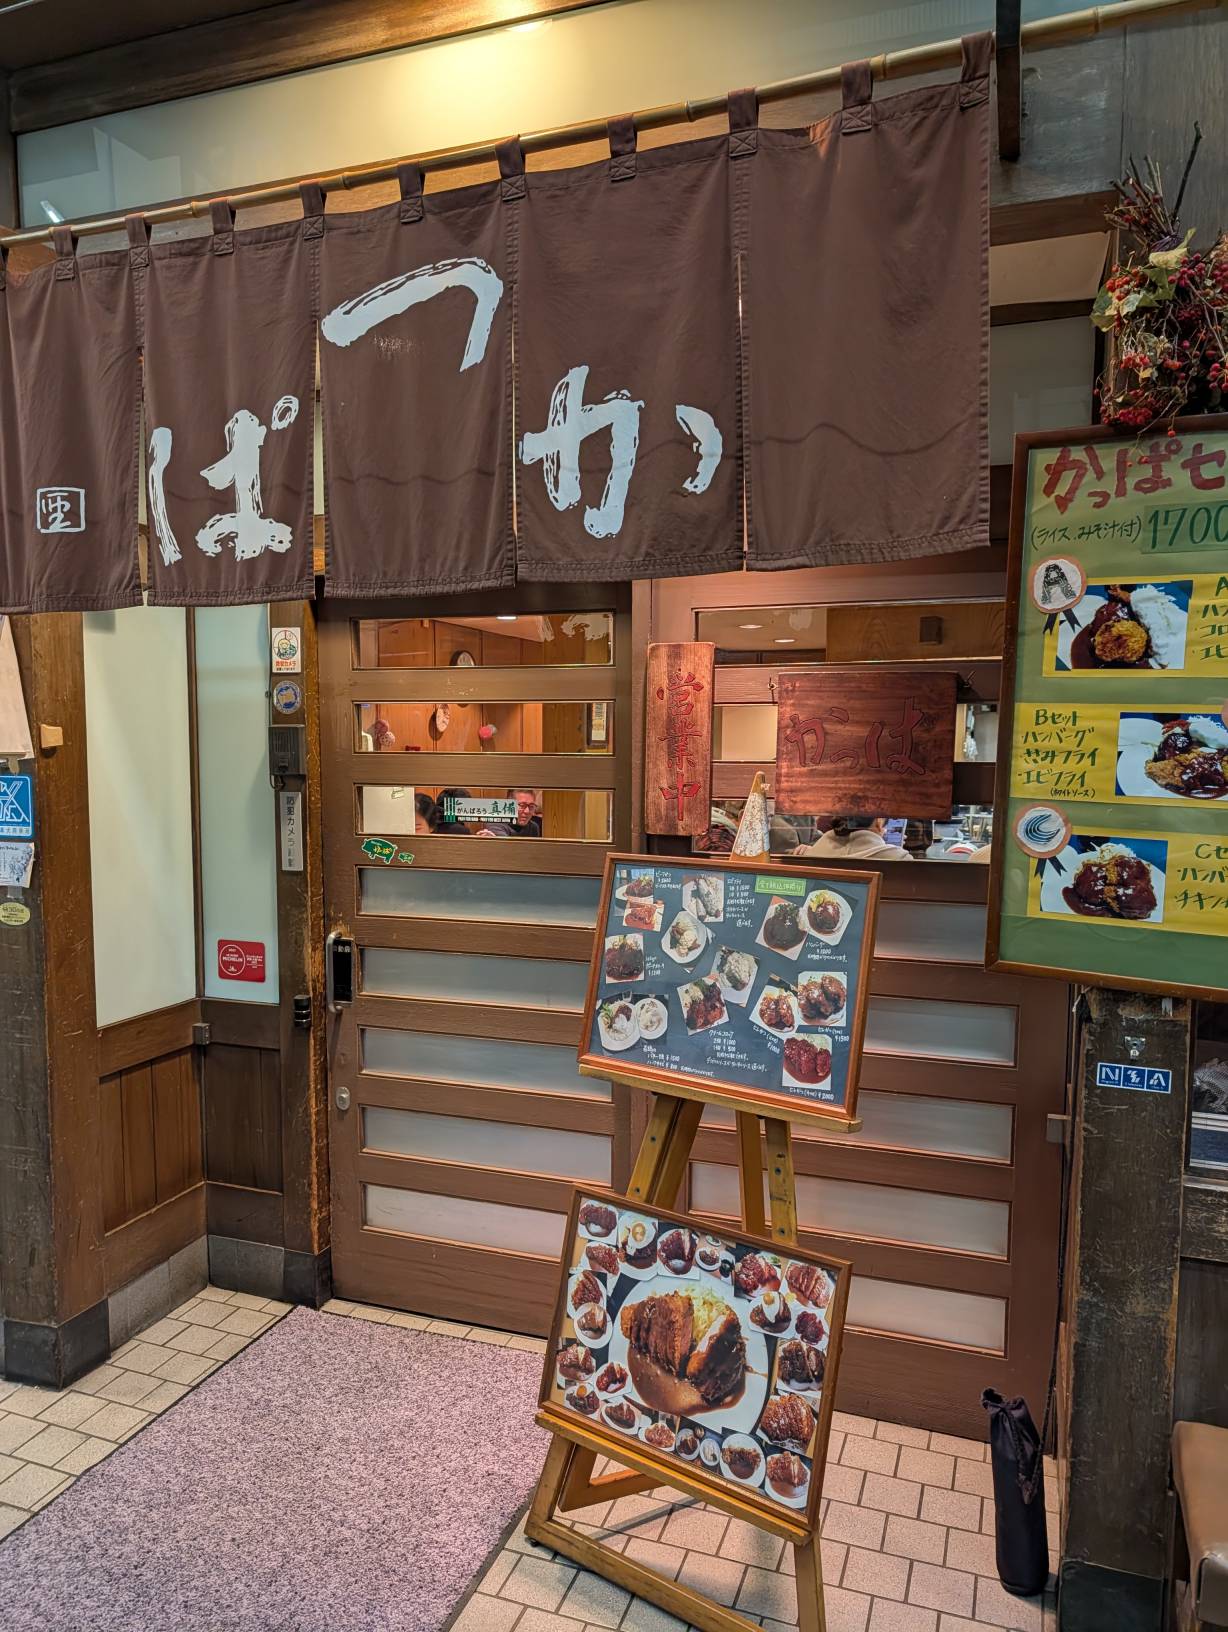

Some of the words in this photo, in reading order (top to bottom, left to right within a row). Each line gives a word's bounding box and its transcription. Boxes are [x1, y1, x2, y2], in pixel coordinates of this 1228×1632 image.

[1035, 709, 1082, 726] Bセット
[657, 667, 705, 822] 営業中
[1023, 727, 1095, 748] ハンバーグ
